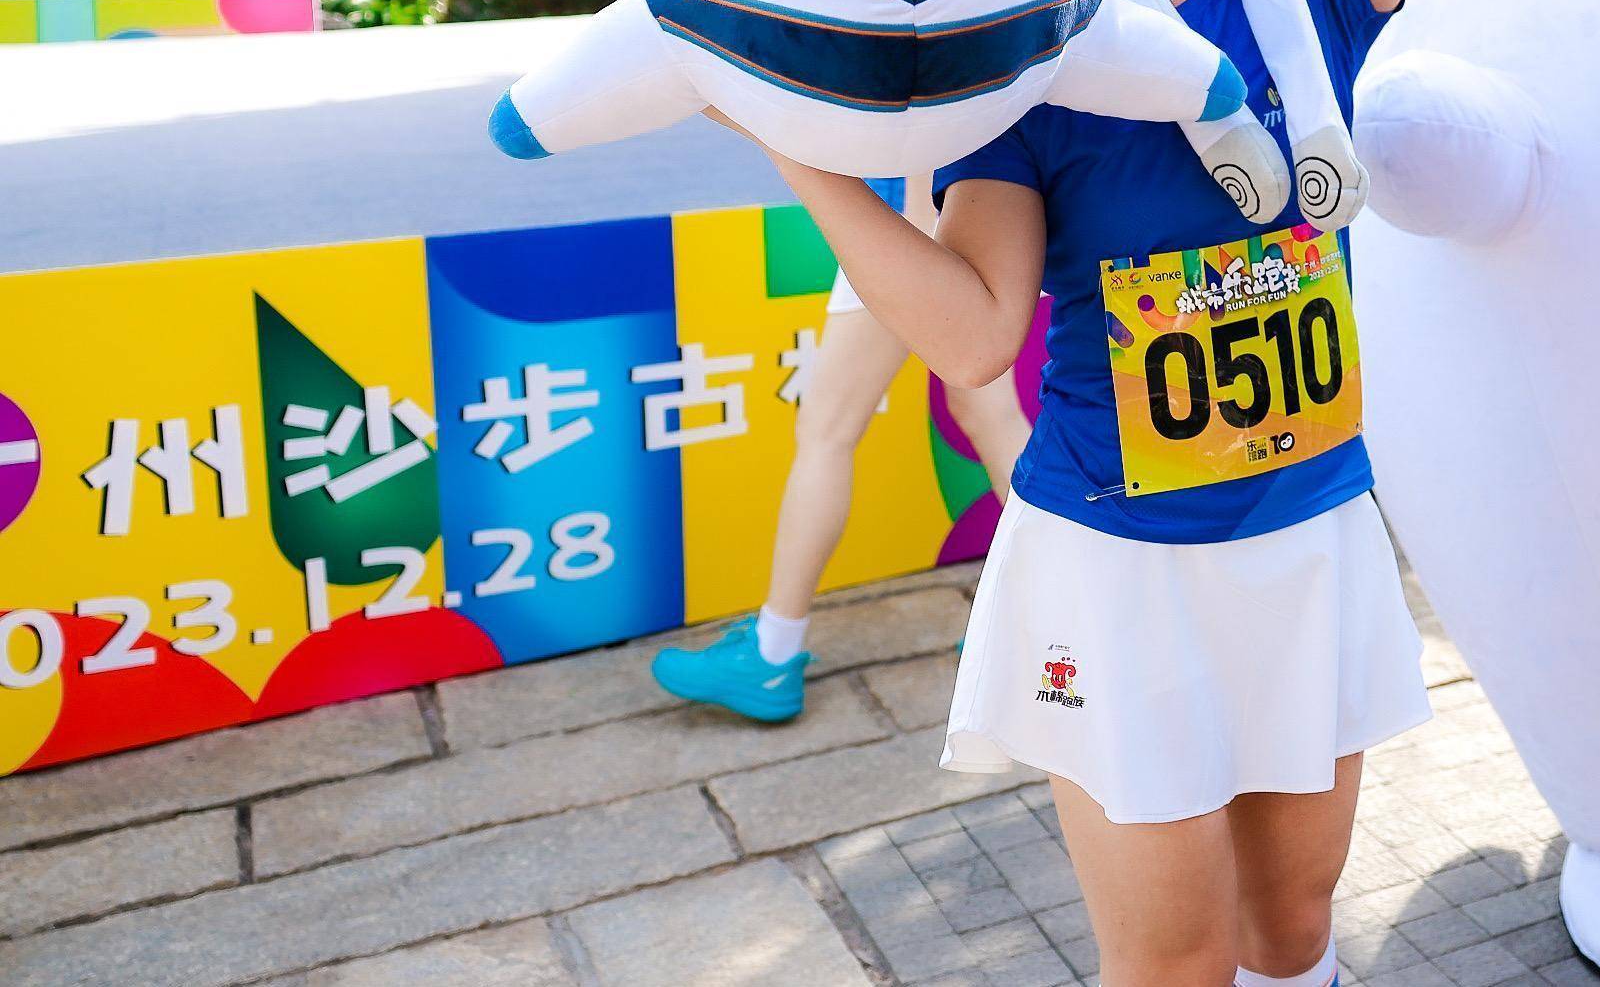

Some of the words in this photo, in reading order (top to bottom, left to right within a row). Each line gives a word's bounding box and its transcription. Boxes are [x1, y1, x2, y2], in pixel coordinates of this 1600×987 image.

[1148, 270, 1181, 283] vanke
[1225, 300, 1246, 313] RUN
[1247, 295, 1267, 307] FOR
[1267, 290, 1287, 303] FUN
[1144, 297, 1343, 441] 0510
[0, 327, 888, 537] 州沙步古
